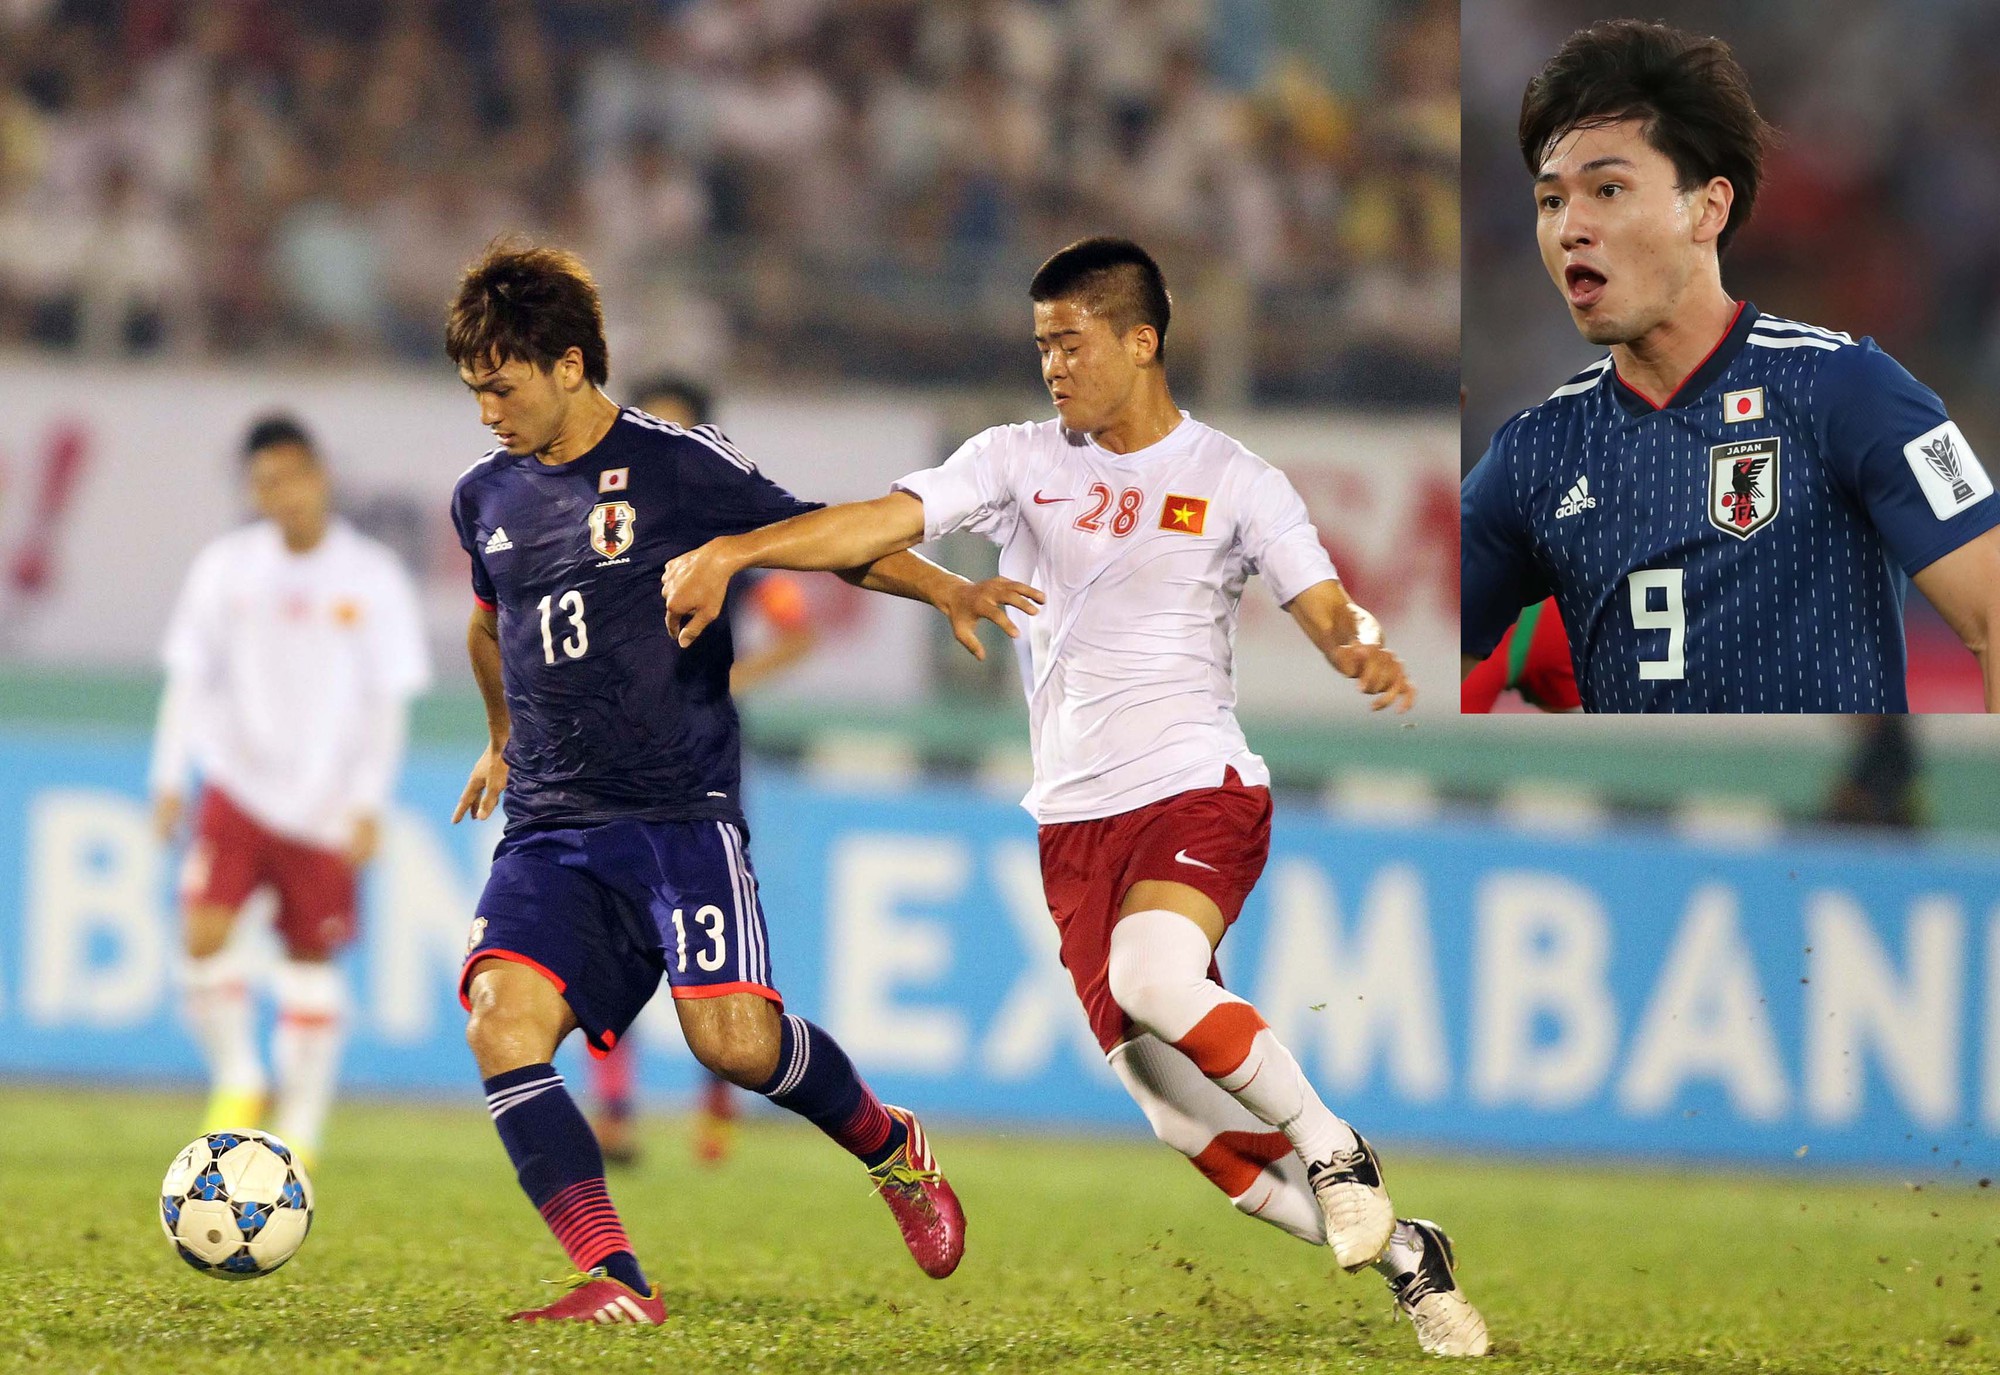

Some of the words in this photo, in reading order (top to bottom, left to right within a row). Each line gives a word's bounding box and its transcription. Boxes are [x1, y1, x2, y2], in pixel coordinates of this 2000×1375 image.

[1727, 443, 1762, 455] JAPAN
[1072, 482, 1144, 538] 28
[1728, 505, 1759, 522] JFA
[536, 590, 589, 665] 13
[1627, 568, 1688, 680] 9
[671, 904, 726, 973] 13
